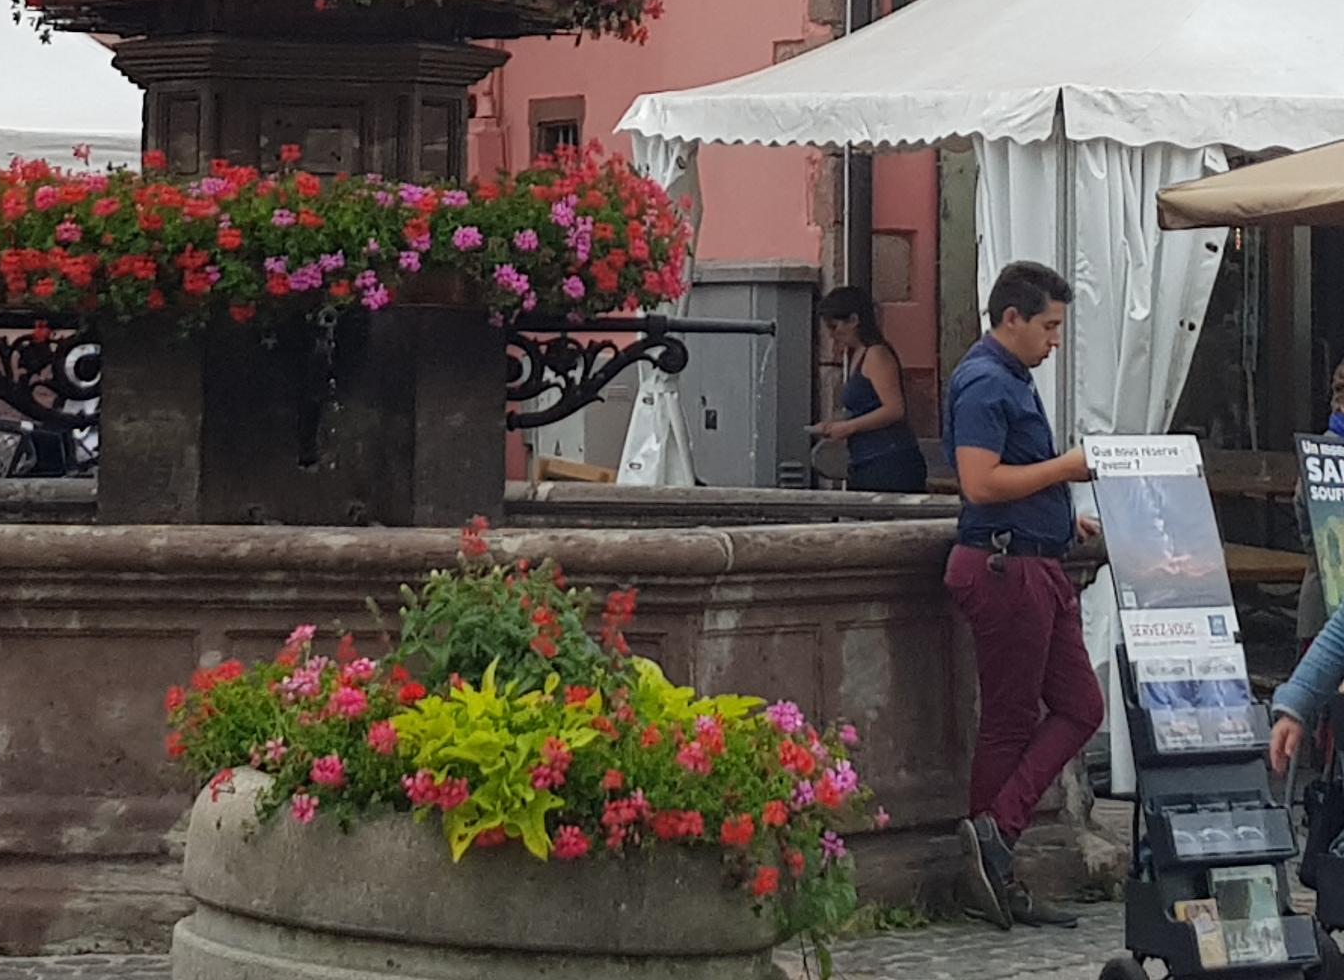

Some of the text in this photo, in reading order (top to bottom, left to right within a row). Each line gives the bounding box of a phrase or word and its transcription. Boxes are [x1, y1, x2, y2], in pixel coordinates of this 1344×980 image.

[1091, 445, 1113, 457] Que
[1115, 447, 1139, 457] nous
[1301, 440, 1318, 454] Un
